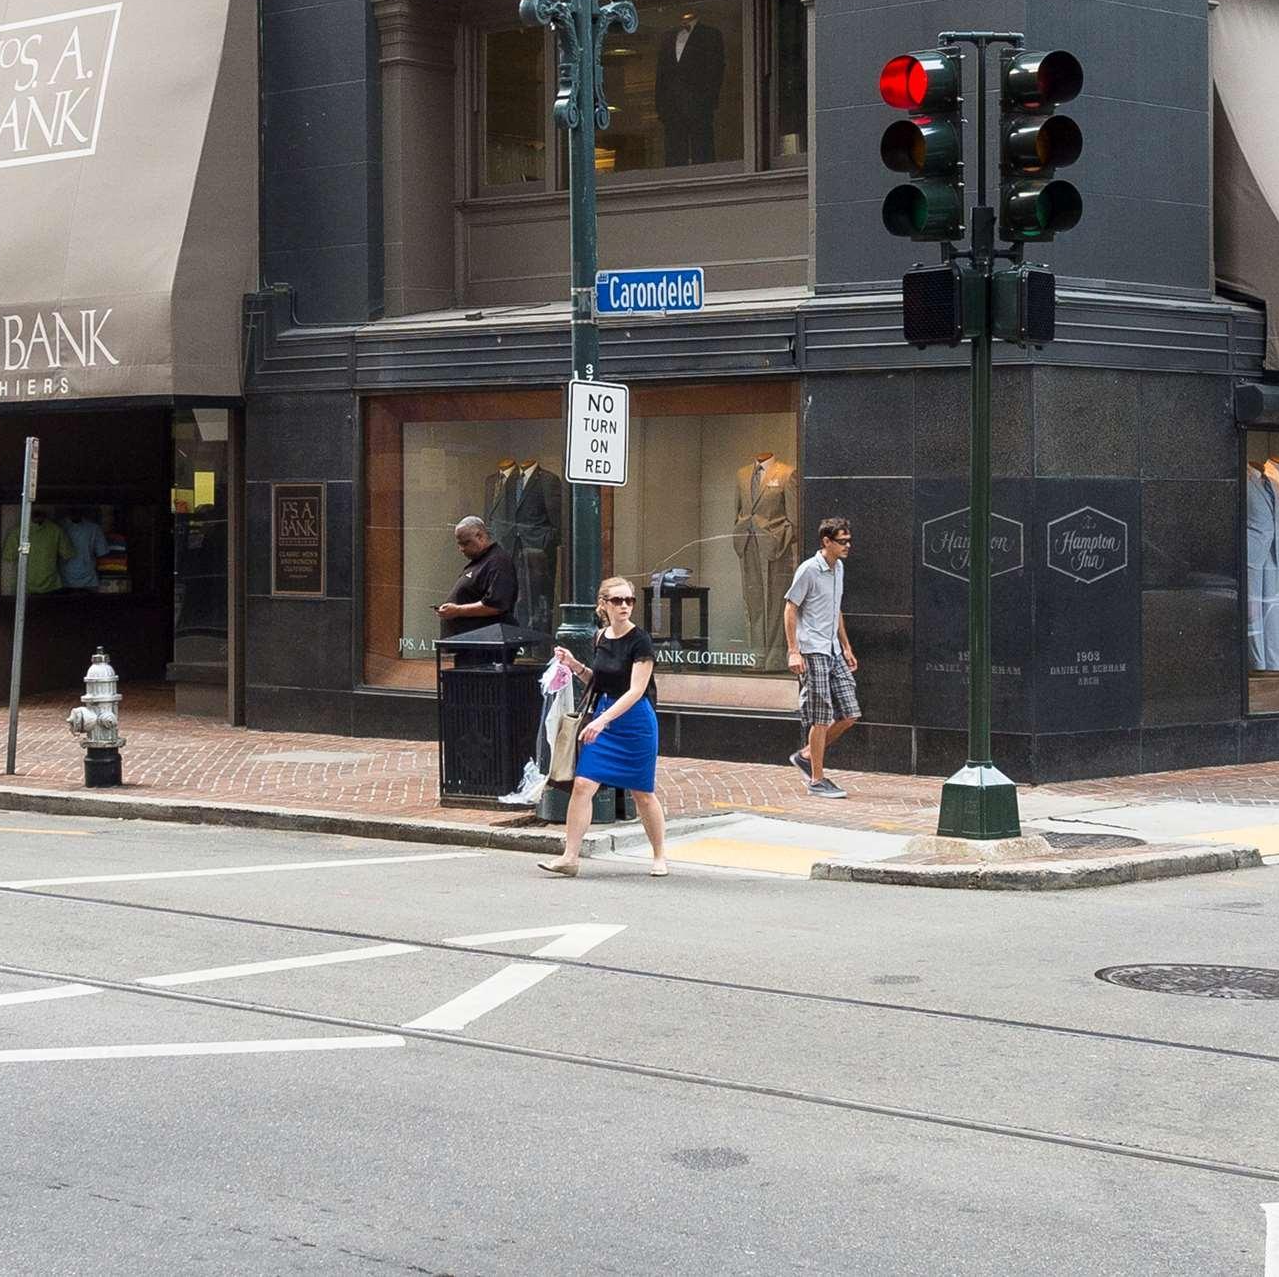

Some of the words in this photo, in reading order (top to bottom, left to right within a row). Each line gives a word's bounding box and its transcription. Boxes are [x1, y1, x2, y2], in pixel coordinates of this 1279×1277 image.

[47, 26, 93, 84] A.
[609, 274, 700, 308] Carondelet
[3, 308, 119, 371] BANK
[588, 394, 614, 413] NO
[584, 418, 617, 434] TURN
[590, 439, 608, 453] ON
[585, 459, 611, 474] RED
[281, 520, 317, 536] BANK
[1056, 530, 1120, 554] Hampton
[1071, 550, 1105, 571] Inn
[418, 639, 429, 651] A.
[686, 650, 757, 667] CLOTHIERS
[1076, 651, 1101, 663] 1903
